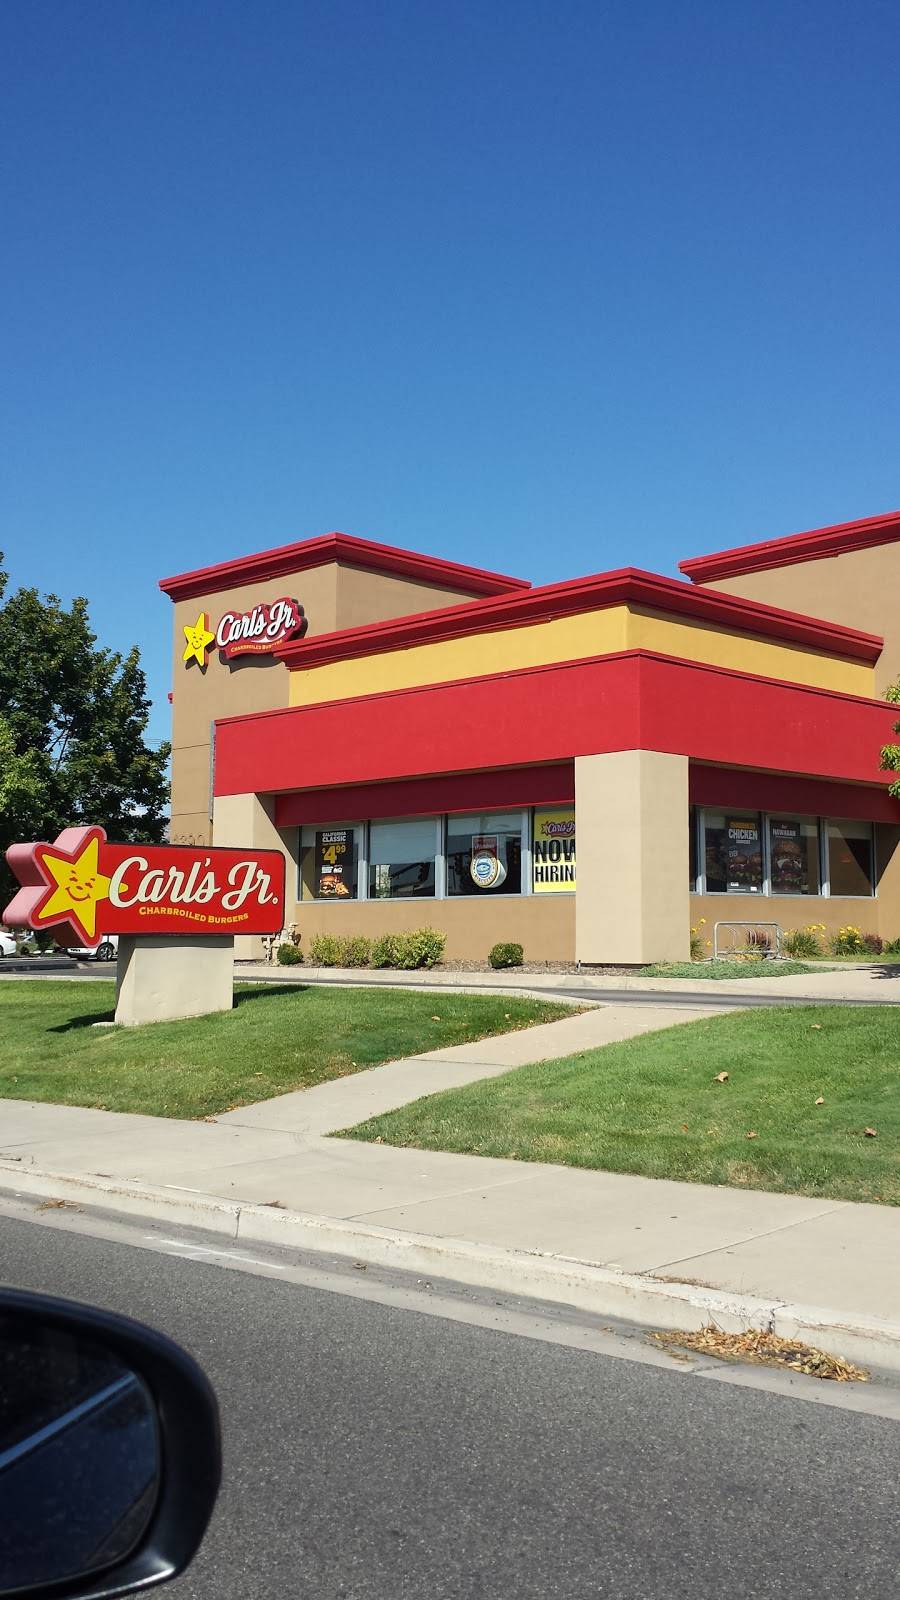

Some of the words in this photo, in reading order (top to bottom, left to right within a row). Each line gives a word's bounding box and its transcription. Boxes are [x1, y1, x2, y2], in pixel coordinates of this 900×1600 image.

[216, 606, 267, 647] Carl's
[267, 601, 296, 636] Jr.
[322, 835, 347, 843] CLASSIC
[728, 828, 758, 840] CHICKEN
[535, 865, 576, 882] HIRIN
[109, 856, 221, 908] Carl's
[221, 861, 279, 911] Jr.
[139, 907, 207, 922] CHARBROILED
[207, 912, 249, 924] BURGERS
